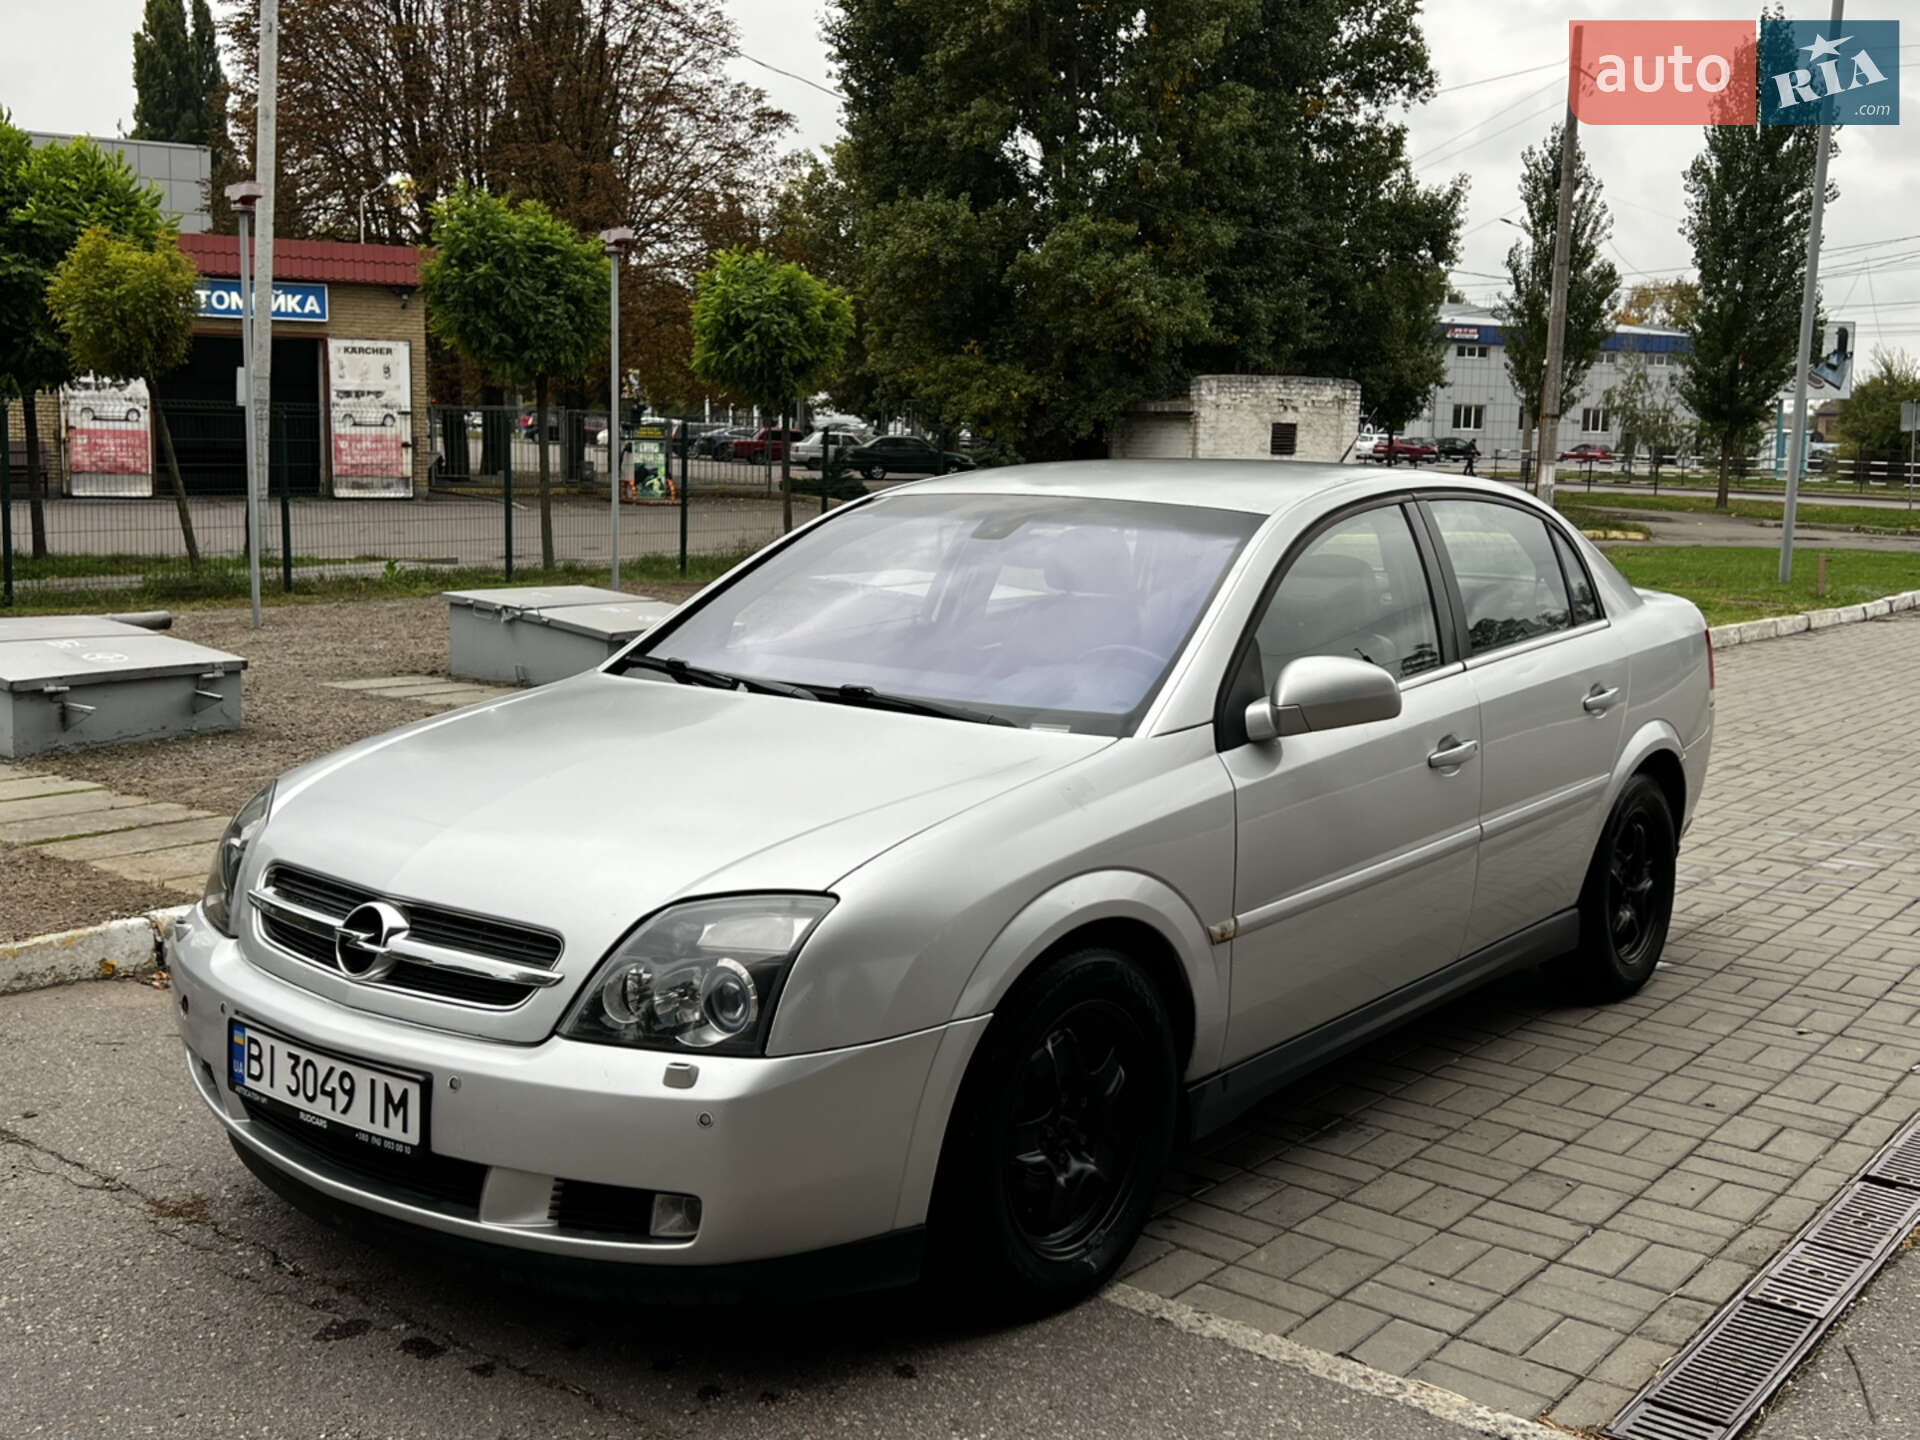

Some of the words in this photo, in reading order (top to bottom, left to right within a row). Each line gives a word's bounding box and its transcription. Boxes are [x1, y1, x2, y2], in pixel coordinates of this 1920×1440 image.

[180, 289, 322, 315] ТОМЙКА
[233, 1060, 244, 1074] UA
[246, 1035, 275, 1089] BI
[286, 1051, 355, 1115] 3049
[369, 1078, 409, 1134] IM
